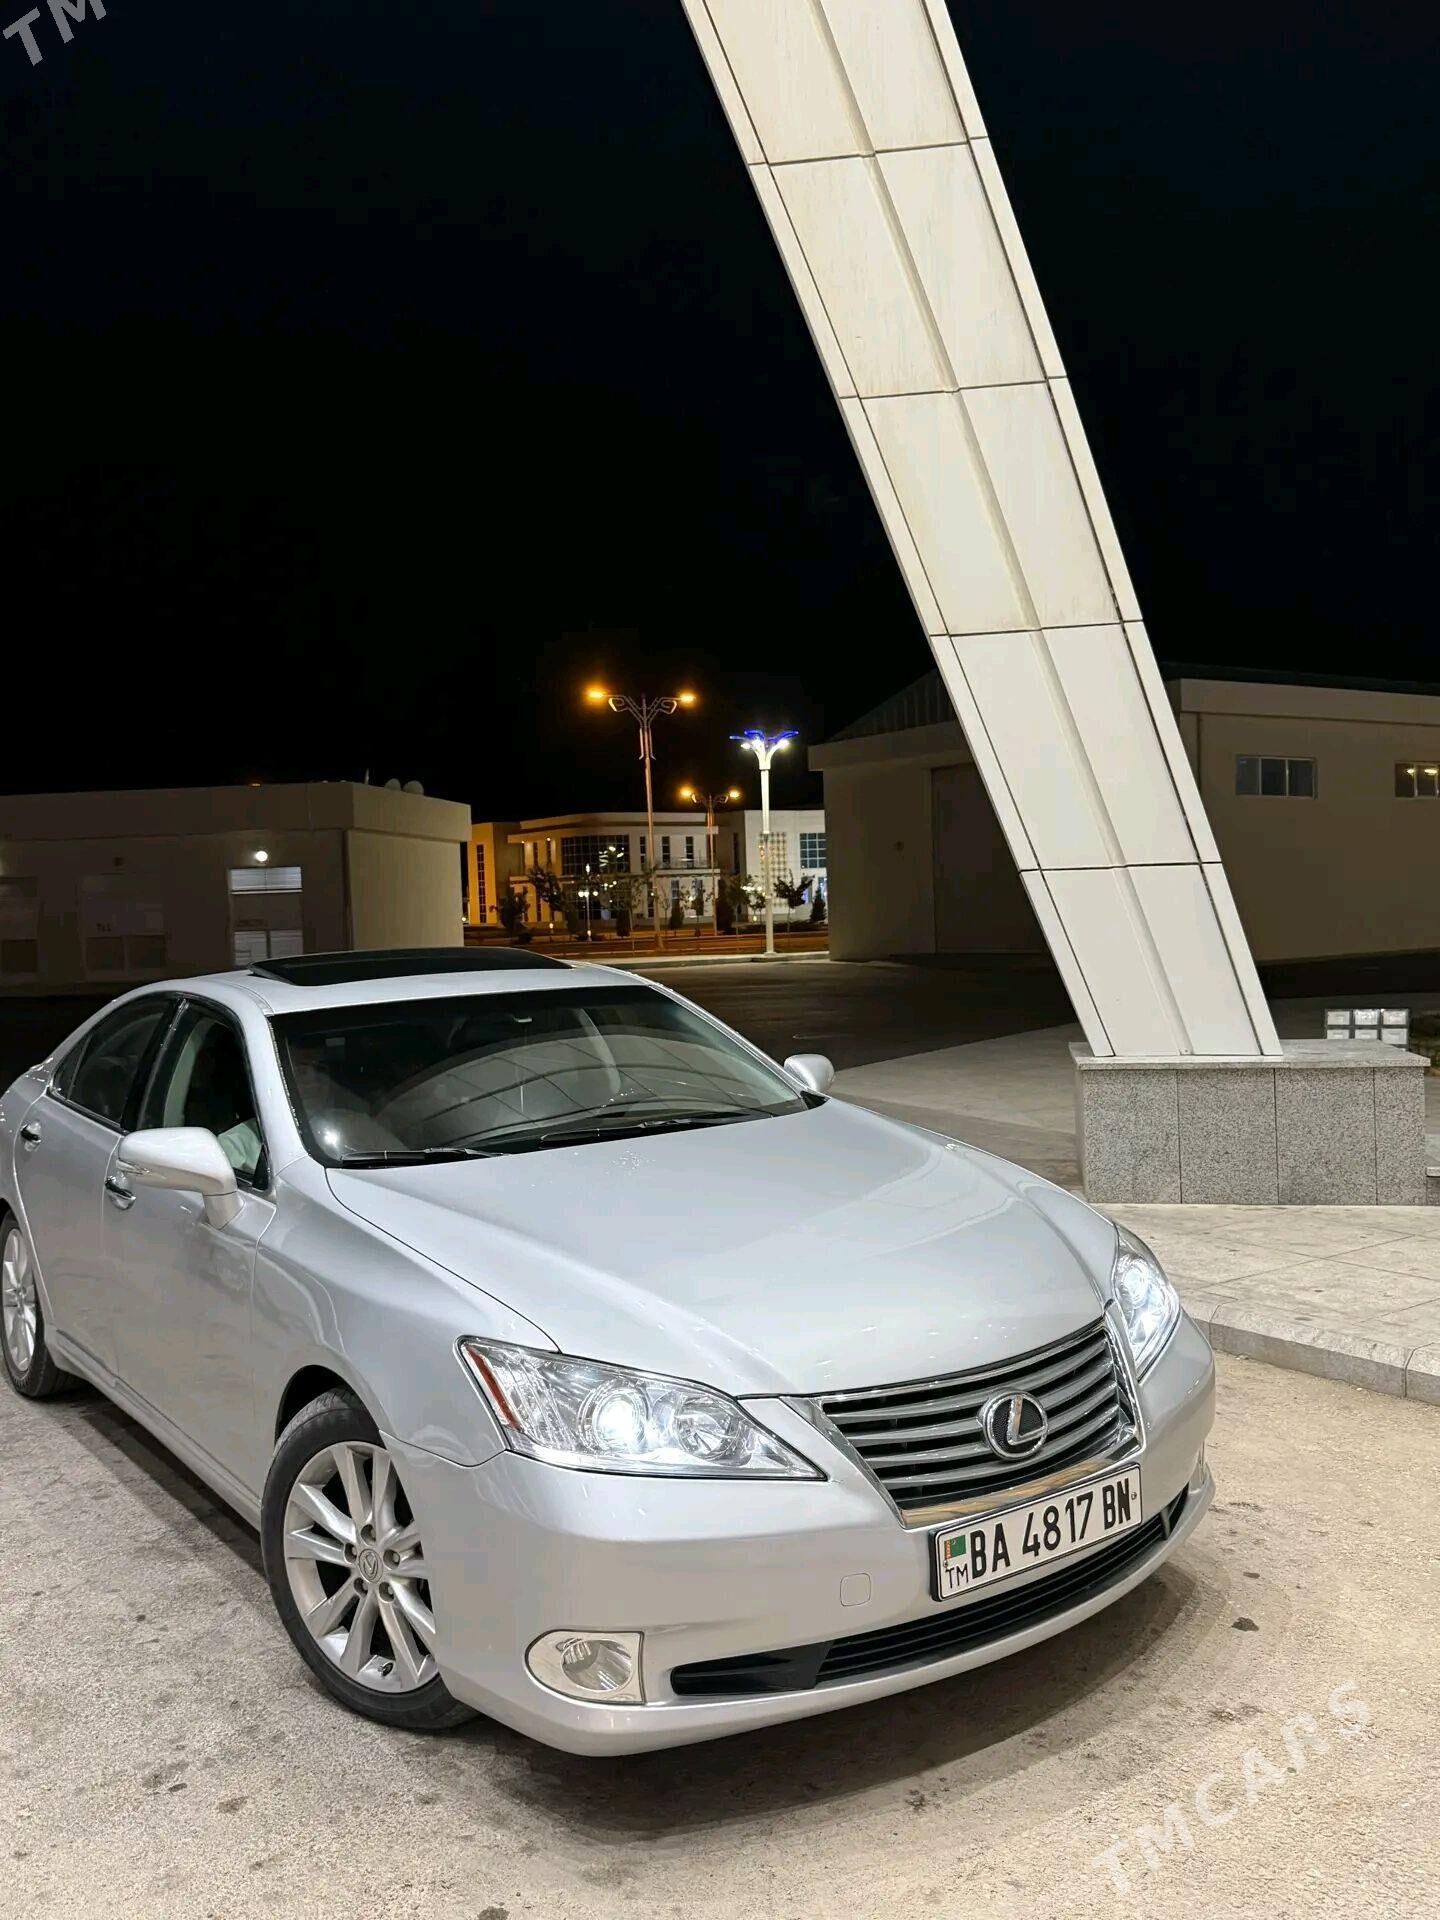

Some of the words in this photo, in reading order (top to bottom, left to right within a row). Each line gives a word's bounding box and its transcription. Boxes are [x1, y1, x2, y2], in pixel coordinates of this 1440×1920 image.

[970, 1522, 1011, 1580] BA
[1022, 1490, 1094, 1557] 4817
[1102, 1477, 1131, 1530] BN
[945, 1563, 969, 1589] TM
